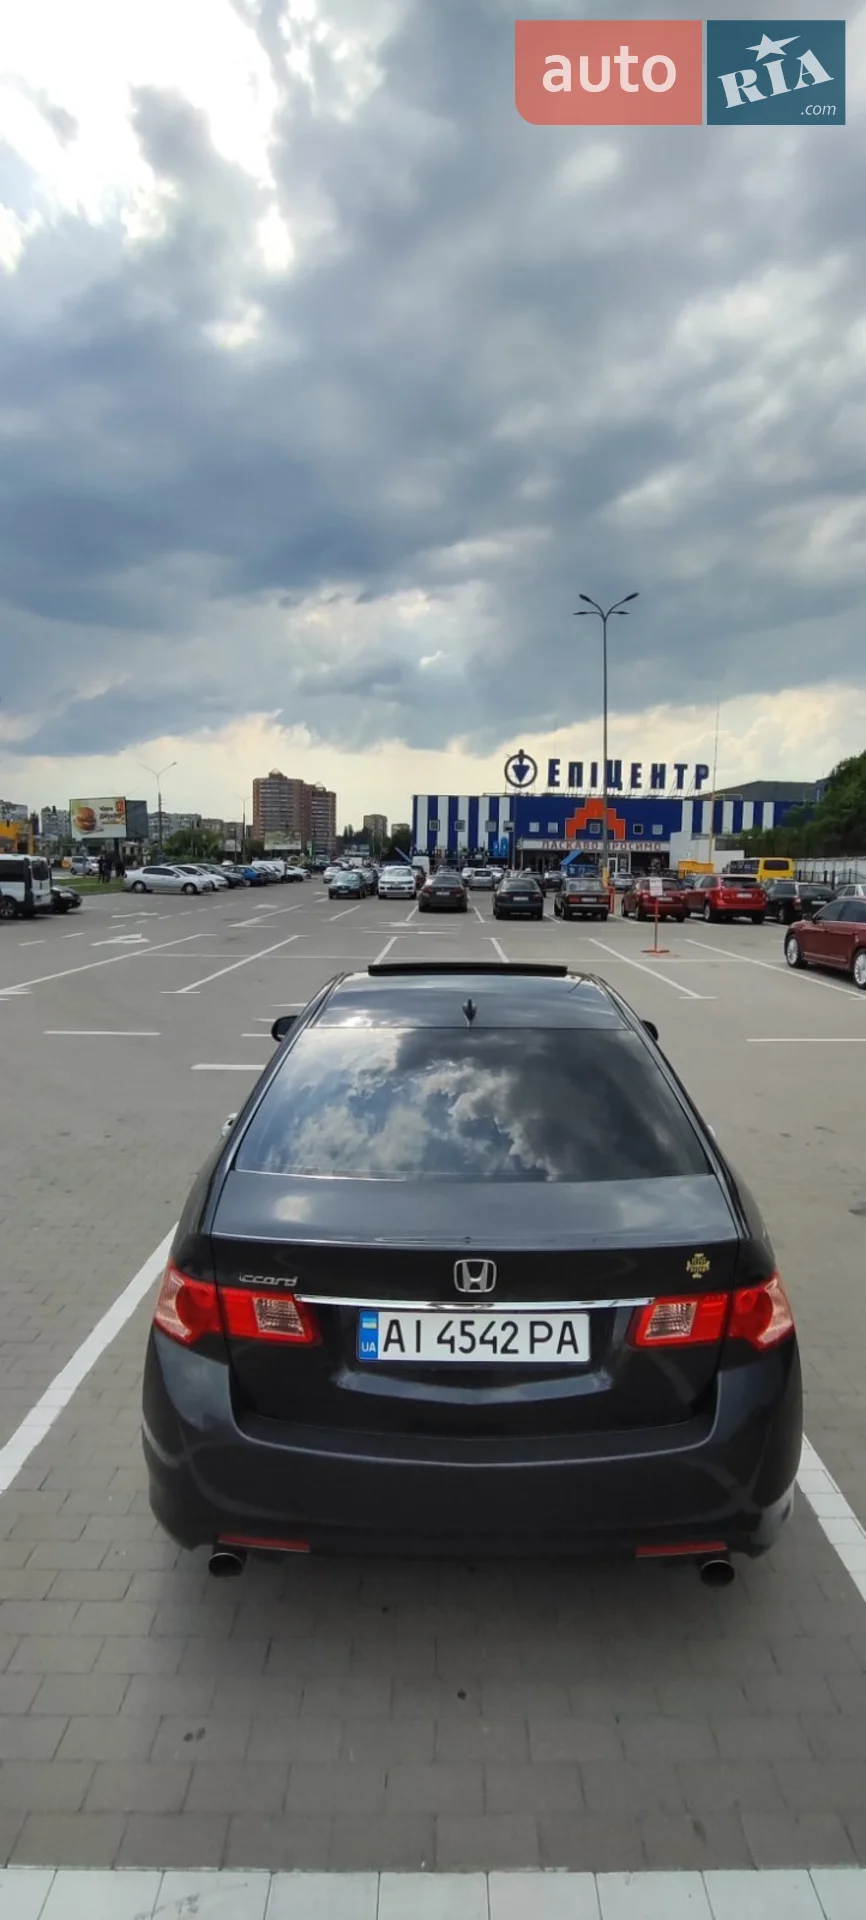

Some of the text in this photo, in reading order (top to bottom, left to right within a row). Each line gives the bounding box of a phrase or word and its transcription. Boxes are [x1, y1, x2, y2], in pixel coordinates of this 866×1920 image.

[547, 758, 709, 791] ЕПІЦЕНТР
[361, 1341, 377, 1353] UA
[383, 1319, 580, 1355] AI 4542 PA
